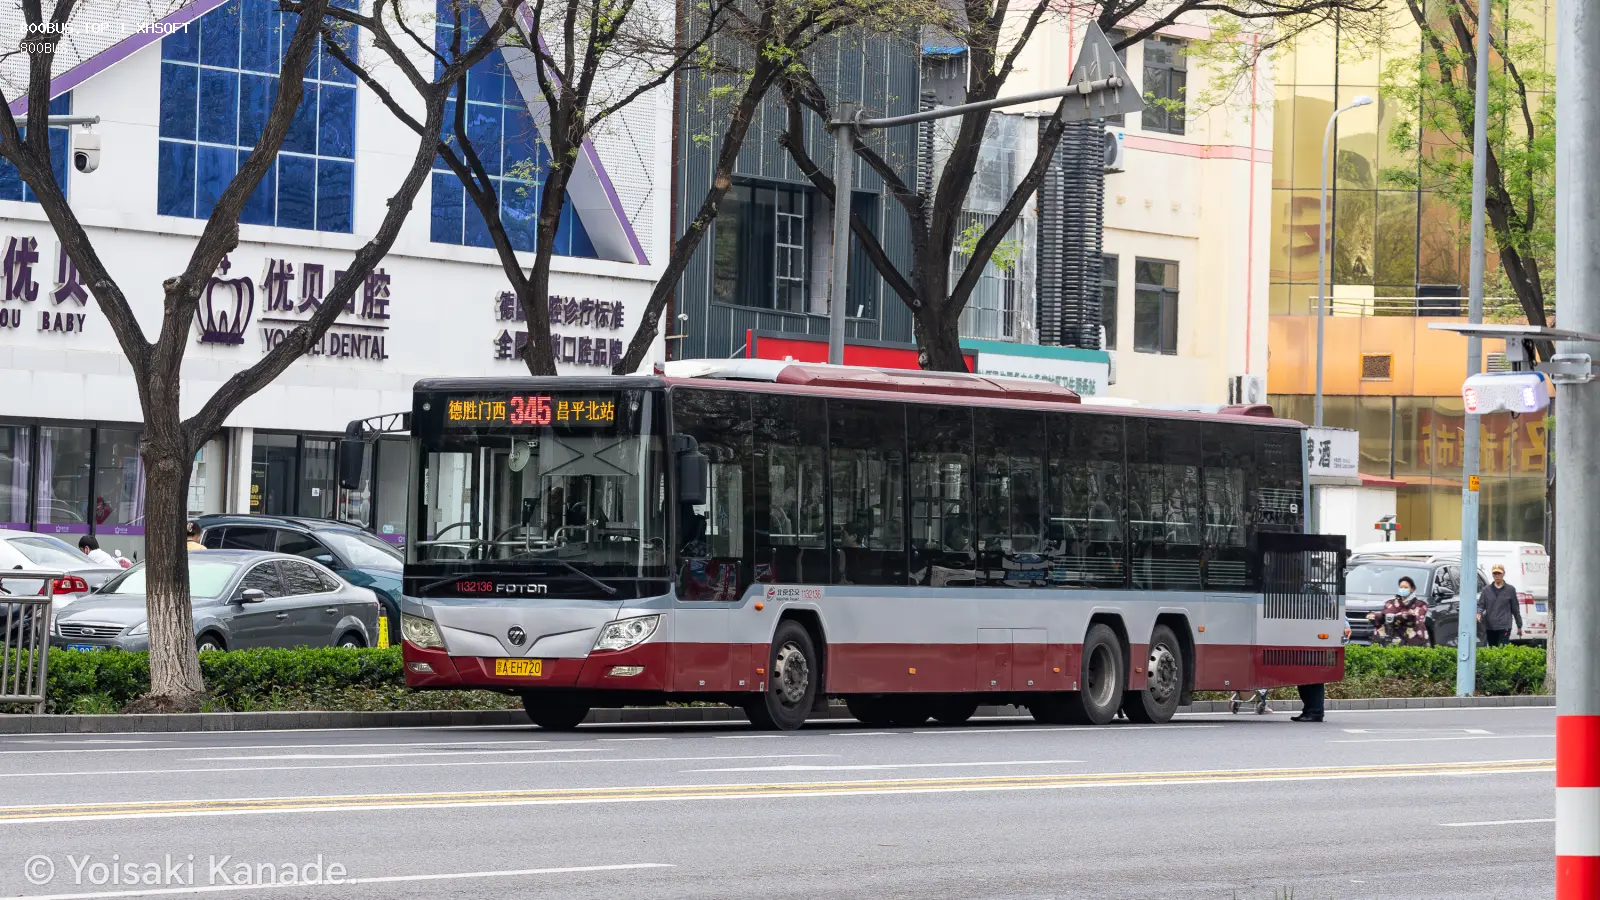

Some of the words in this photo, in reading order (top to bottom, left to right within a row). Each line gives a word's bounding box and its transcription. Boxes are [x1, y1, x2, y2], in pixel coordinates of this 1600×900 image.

[260, 257, 391, 320] 优贝腔
[39, 310, 86, 333] BABY
[329, 332, 389, 360] DENTAL
[448, 400, 506, 421] 德胜门西
[510, 396, 552, 425] 345
[556, 400, 615, 421] 昌平北站
[456, 582, 493, 592] 1132136
[496, 583, 548, 594] FOTON
